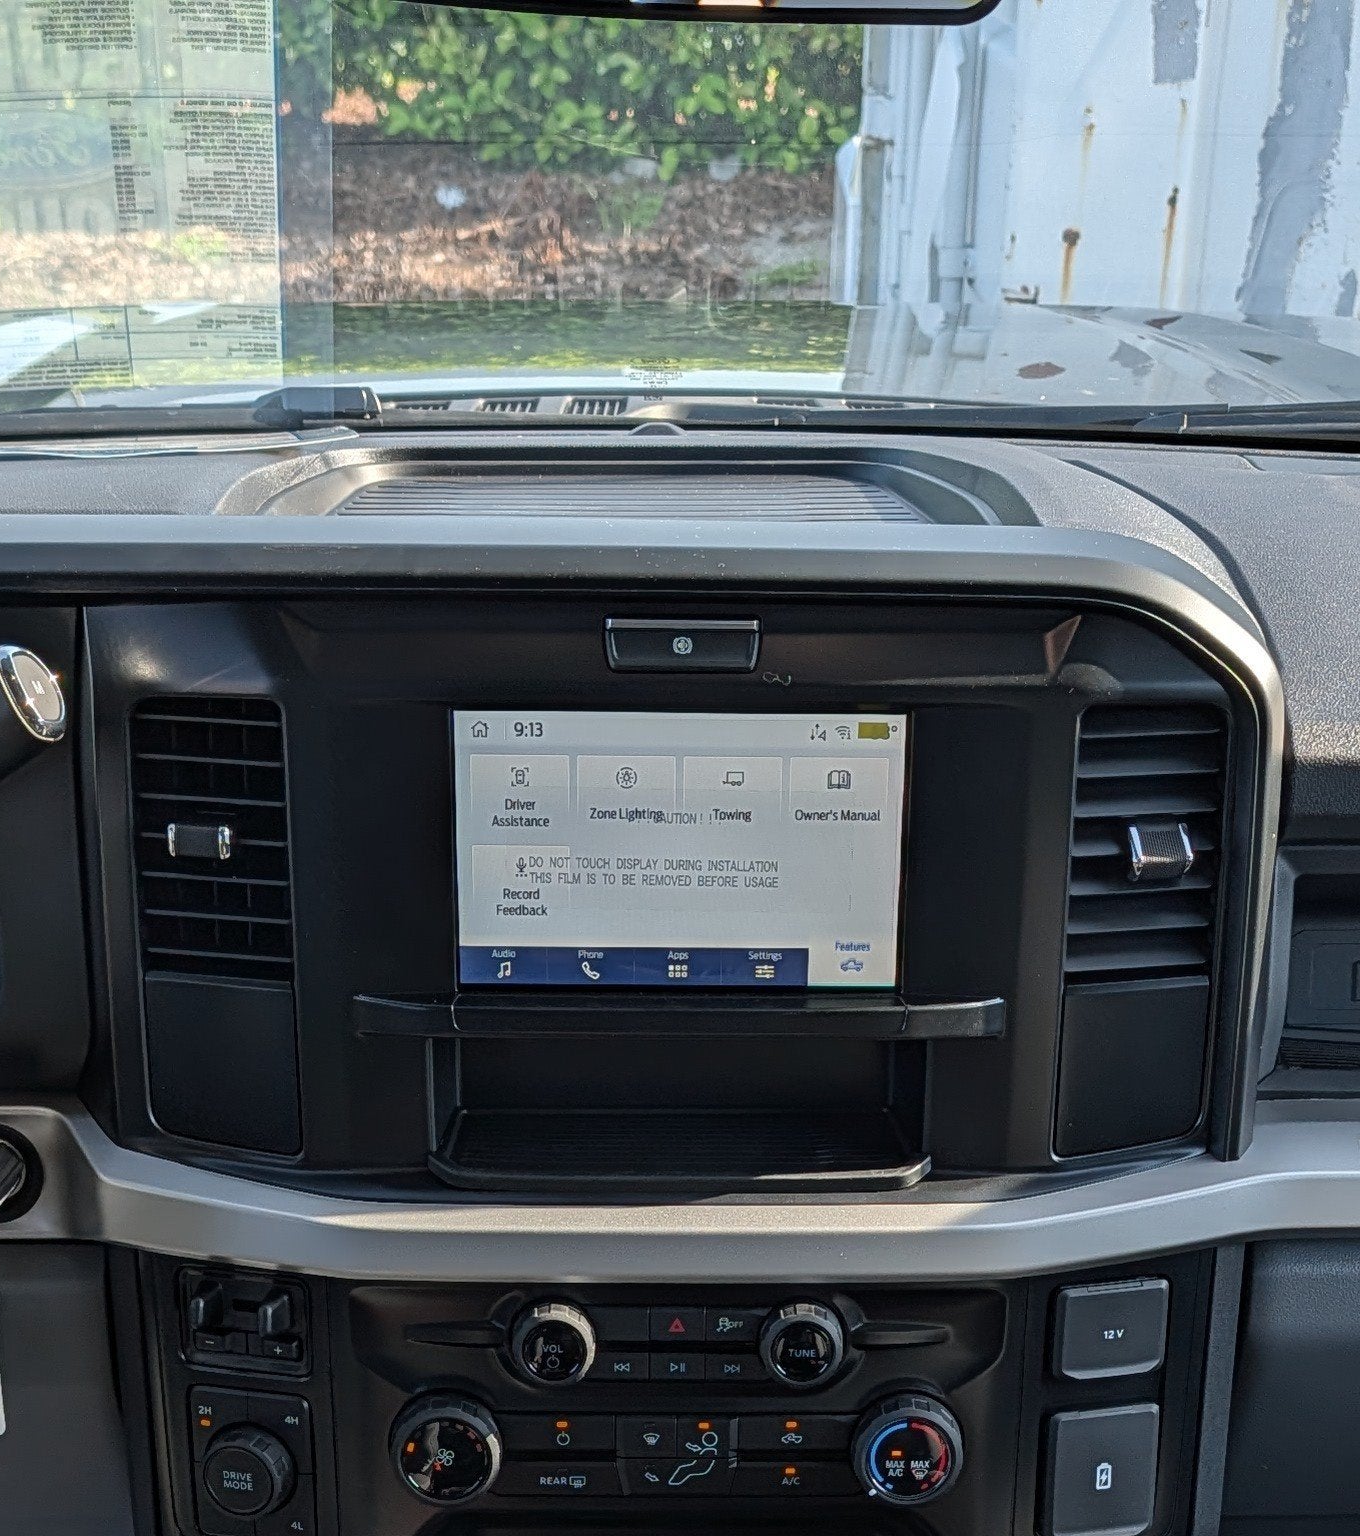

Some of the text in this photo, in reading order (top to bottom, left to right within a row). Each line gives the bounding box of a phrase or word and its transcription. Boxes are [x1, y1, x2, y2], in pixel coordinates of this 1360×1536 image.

[513, 721, 544, 739] 9:13
[504, 799, 536, 812] Driver
[589, 807, 618, 821] Zone
[712, 808, 753, 823] Towing
[794, 809, 881, 823] Owner's Manual
[491, 814, 551, 828] Assistance
[529, 857, 779, 873] DO NOT TOUCH DISPLAY DURING INSTALLATION
[529, 873, 779, 889] THIS FILM IS TO BE REMOVED BEFORE USAGE
[502, 888, 541, 901] Record
[495, 904, 549, 917] Feedback
[834, 940, 871, 953] Features
[490, 949, 517, 959] Audio
[577, 950, 605, 959] Phone
[667, 950, 690, 961] Apps
[747, 950, 783, 963] Settings
[1103, 1329, 1125, 1340] 12 V
[541, 1344, 564, 1354] VOL
[788, 1348, 818, 1358] TUNE
[198, 1405, 213, 1415] 2H
[284, 1415, 299, 1426] 4H
[885, 1460, 906, 1469] MAX
[910, 1460, 931, 1469] MAX
[222, 1470, 253, 1482] DRIVE
[887, 1469, 904, 1477] A/C
[223, 1480, 254, 1491] MODE
[539, 1476, 568, 1486] REAR
[781, 1476, 801, 1486] A/C
[290, 1521, 304, 1531] 4L
